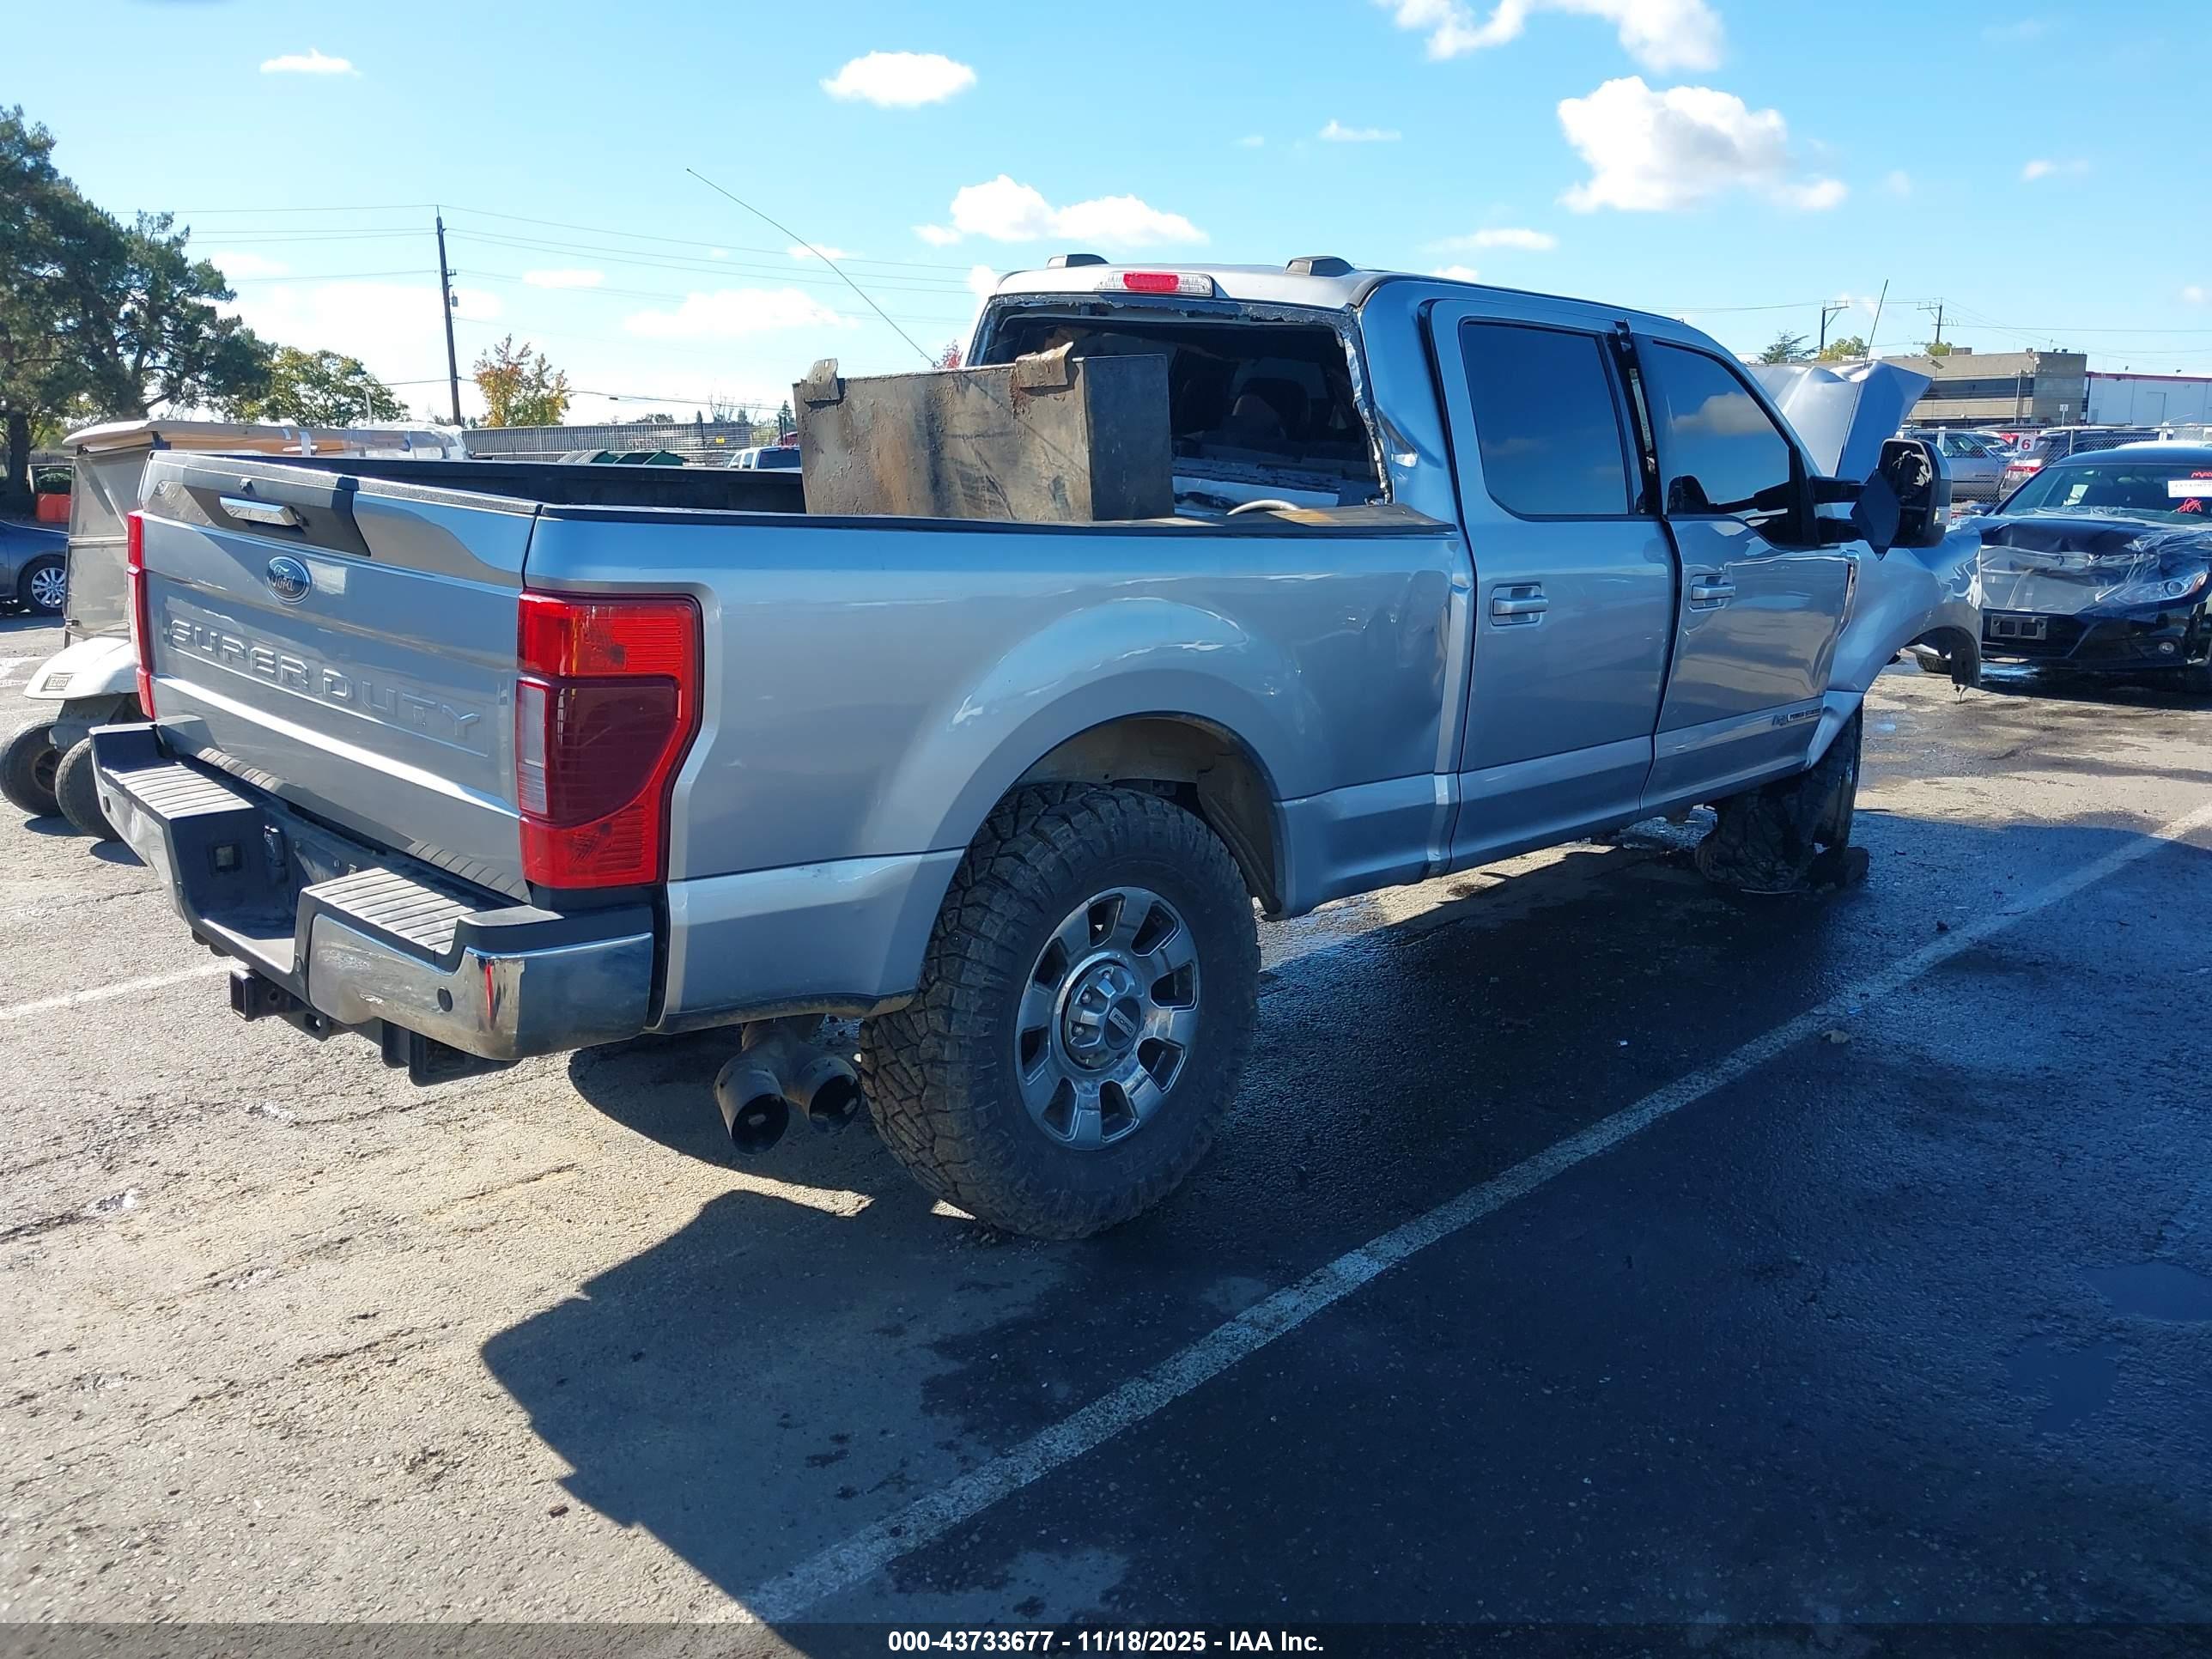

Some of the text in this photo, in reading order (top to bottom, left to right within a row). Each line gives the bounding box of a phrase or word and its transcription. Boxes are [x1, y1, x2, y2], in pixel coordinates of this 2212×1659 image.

[2021, 439, 2031, 451] 6
[170, 619, 482, 740] SUPER DUTY
[1113, 1013, 1134, 1034] FORD
